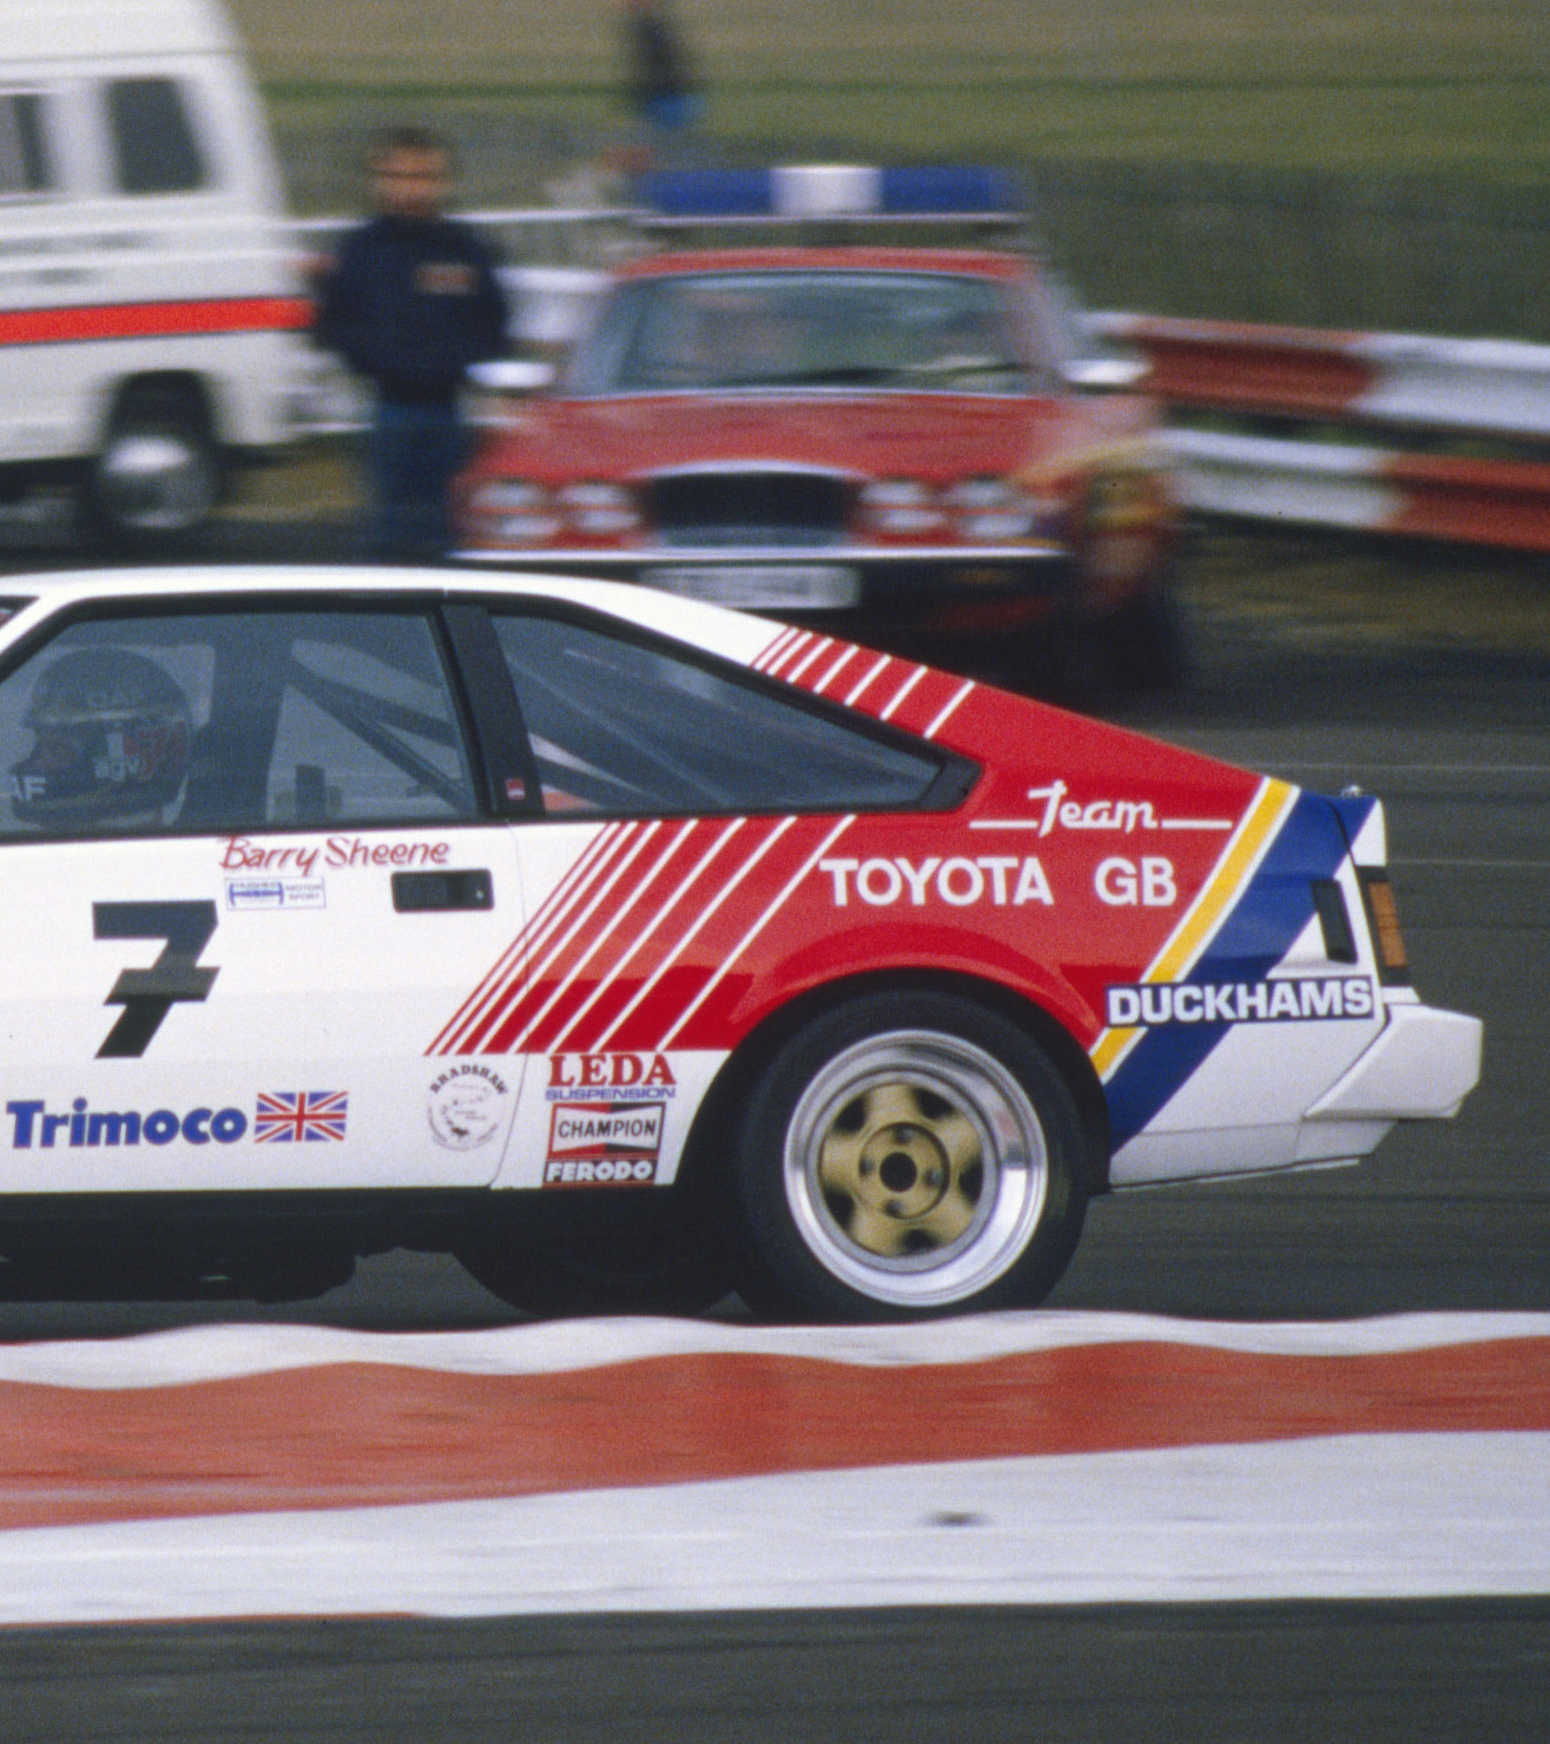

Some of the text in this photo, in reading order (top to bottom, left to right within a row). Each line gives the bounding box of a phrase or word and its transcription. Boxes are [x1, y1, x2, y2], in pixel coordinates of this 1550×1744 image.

[1027, 779, 1155, 837] Team
[218, 834, 450, 877] Barry Sheene
[819, 855, 1178, 907] TOYOTA GB
[92, 900, 221, 1059] 7
[1107, 979, 1373, 1027] DUCKHAMS
[430, 1064, 508, 1095] BRADSHAW
[548, 1054, 677, 1087] LEDA
[546, 1087, 675, 1100] SUSPENSION
[6, 1097, 248, 1149] Trimoco
[558, 1118, 656, 1139] CHAMPION
[547, 1159, 653, 1182] FERODO
